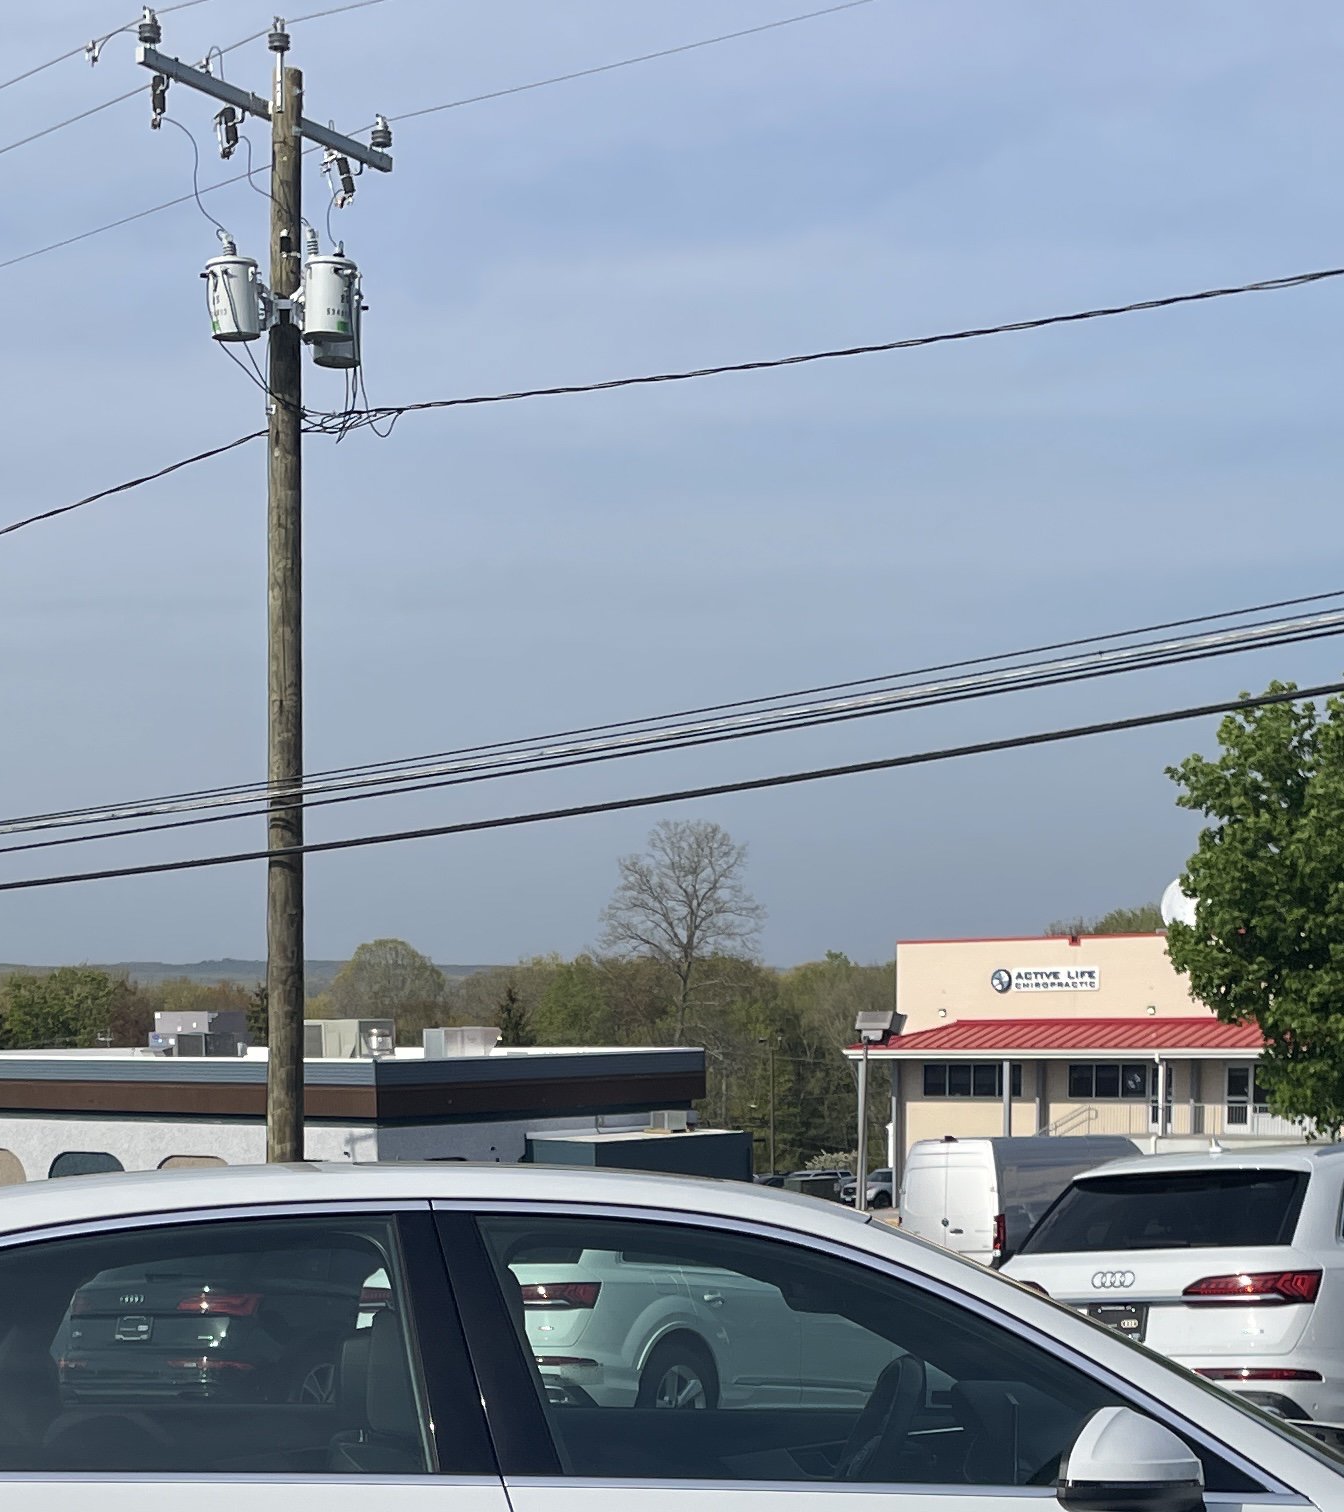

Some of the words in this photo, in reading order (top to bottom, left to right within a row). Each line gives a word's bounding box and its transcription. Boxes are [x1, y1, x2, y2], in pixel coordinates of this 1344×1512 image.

[1015, 971, 1061, 981] ACTIVE
[1067, 970, 1096, 980] LIFE
[1015, 981, 1096, 990] CHIROPRACTIC
